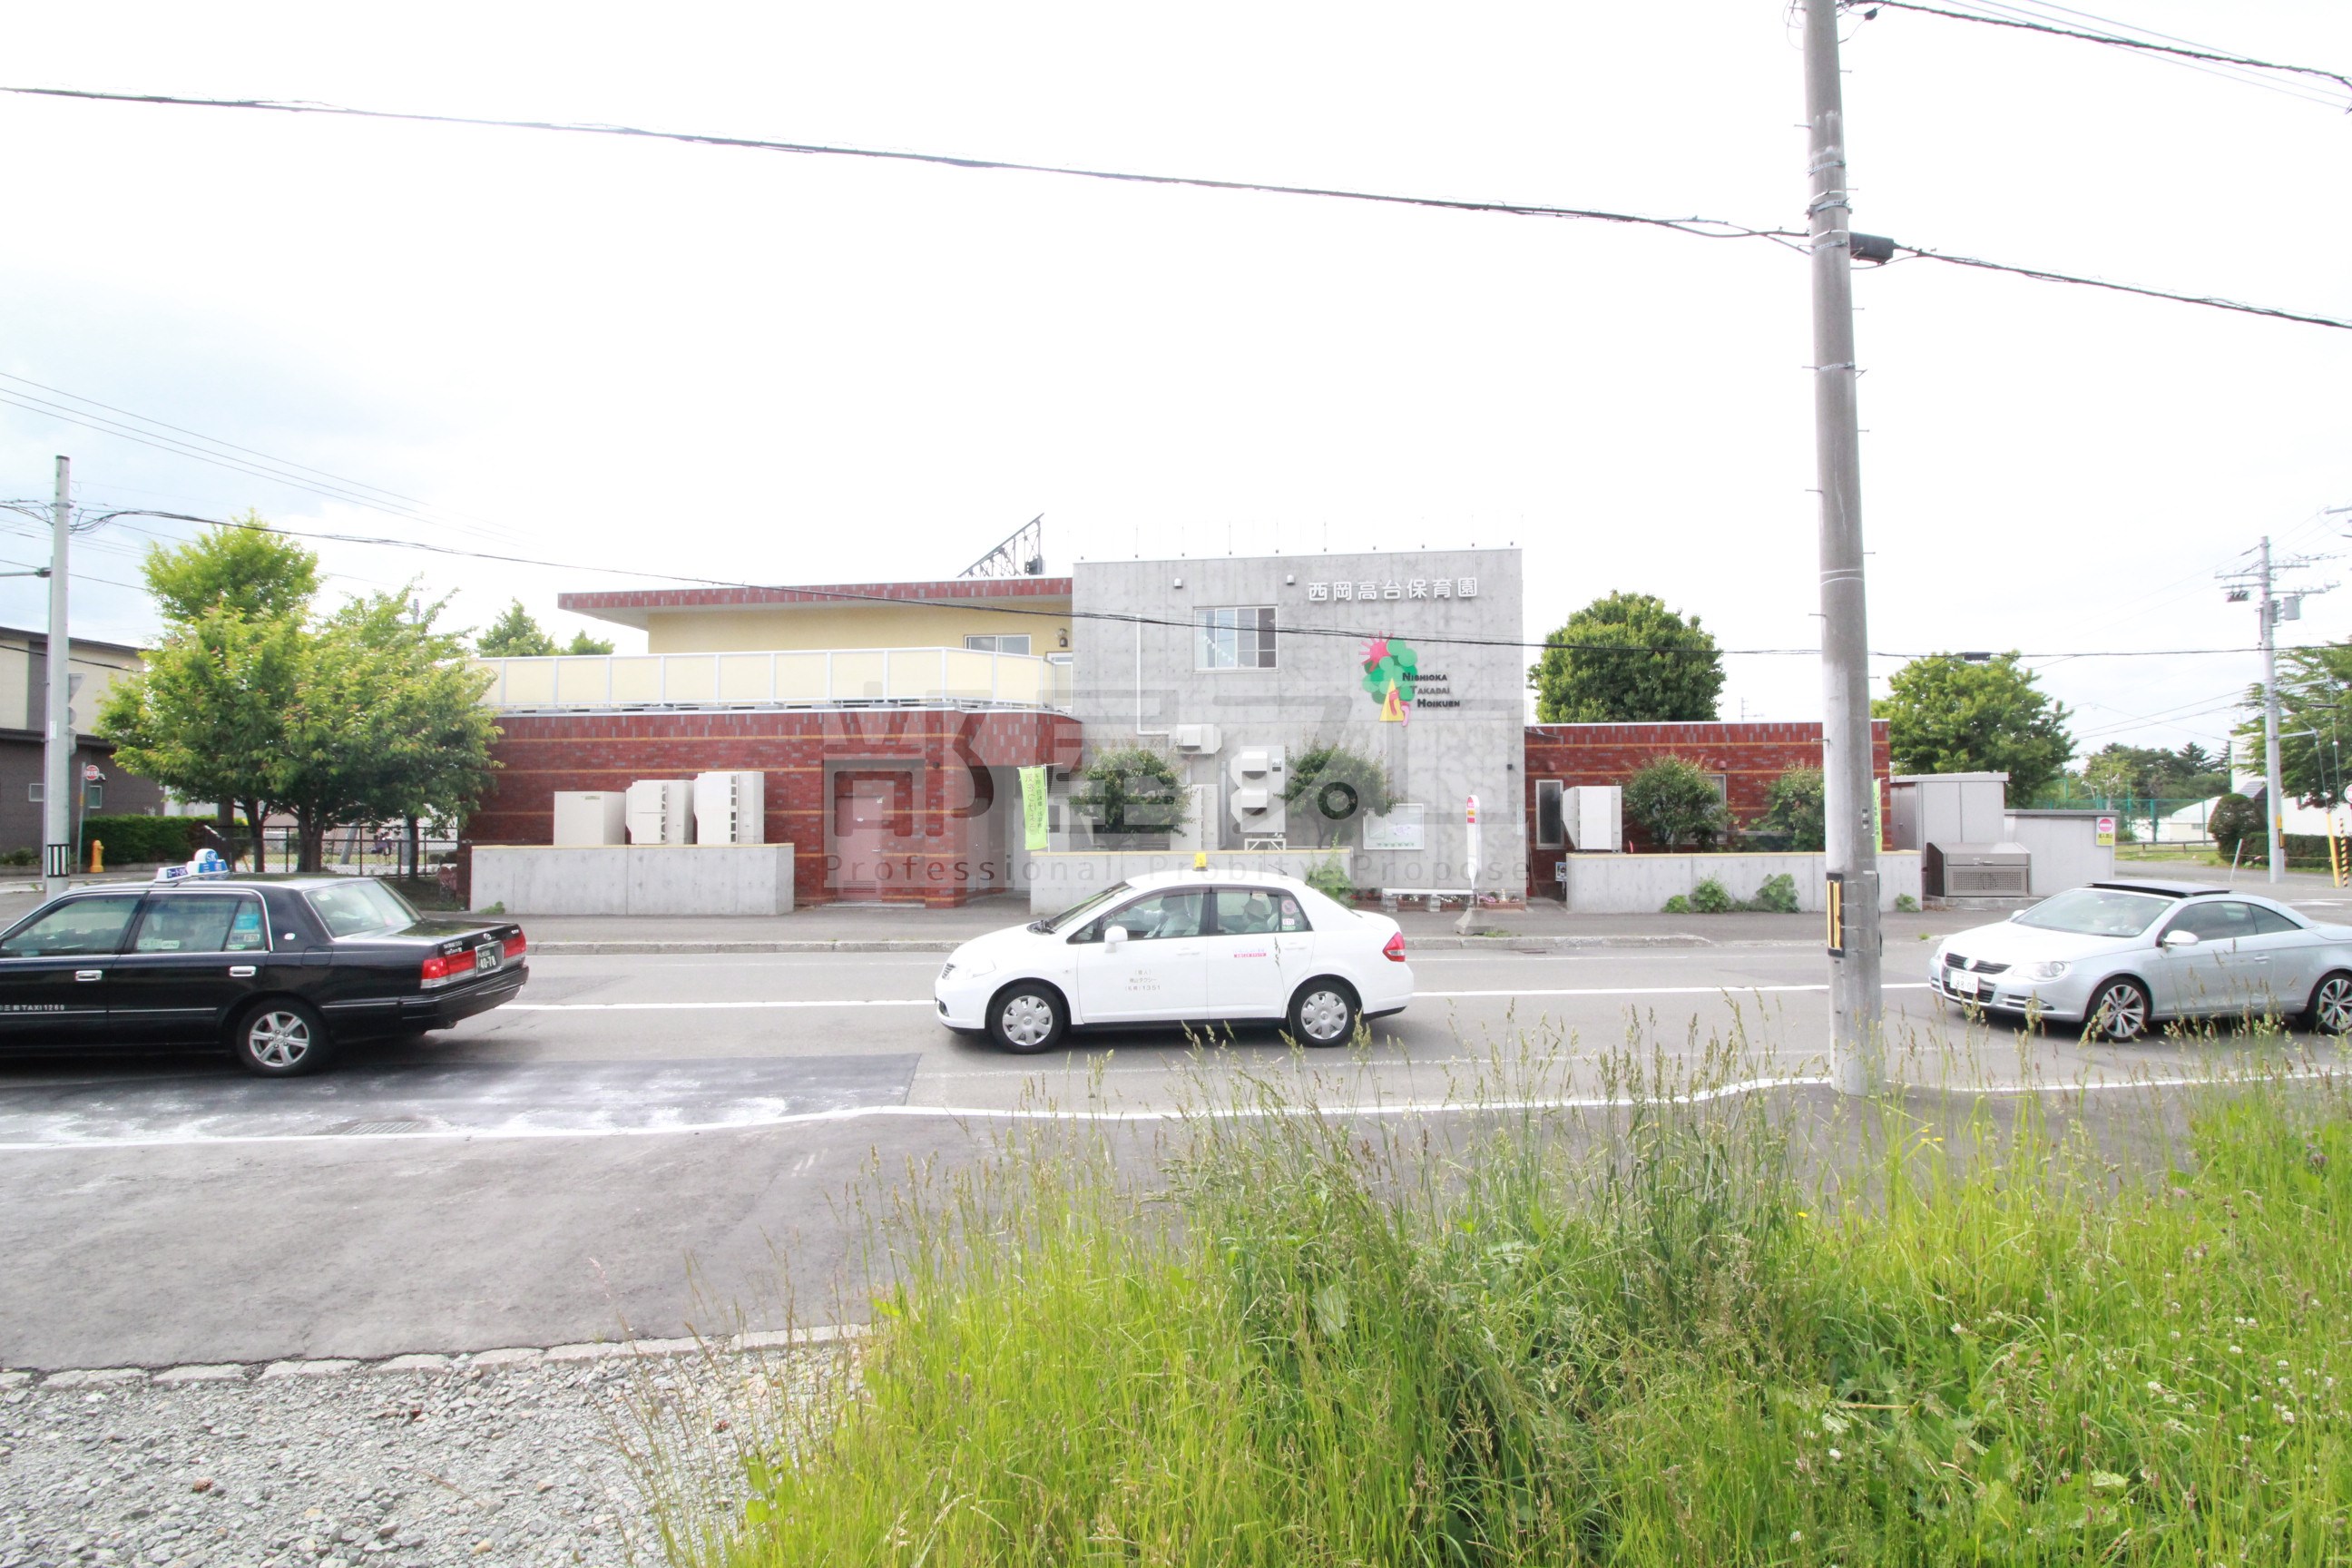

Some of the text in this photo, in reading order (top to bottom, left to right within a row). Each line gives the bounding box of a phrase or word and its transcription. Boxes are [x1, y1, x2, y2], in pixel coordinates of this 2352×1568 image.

[1308, 576, 1477, 601] 西岡高台保育園
